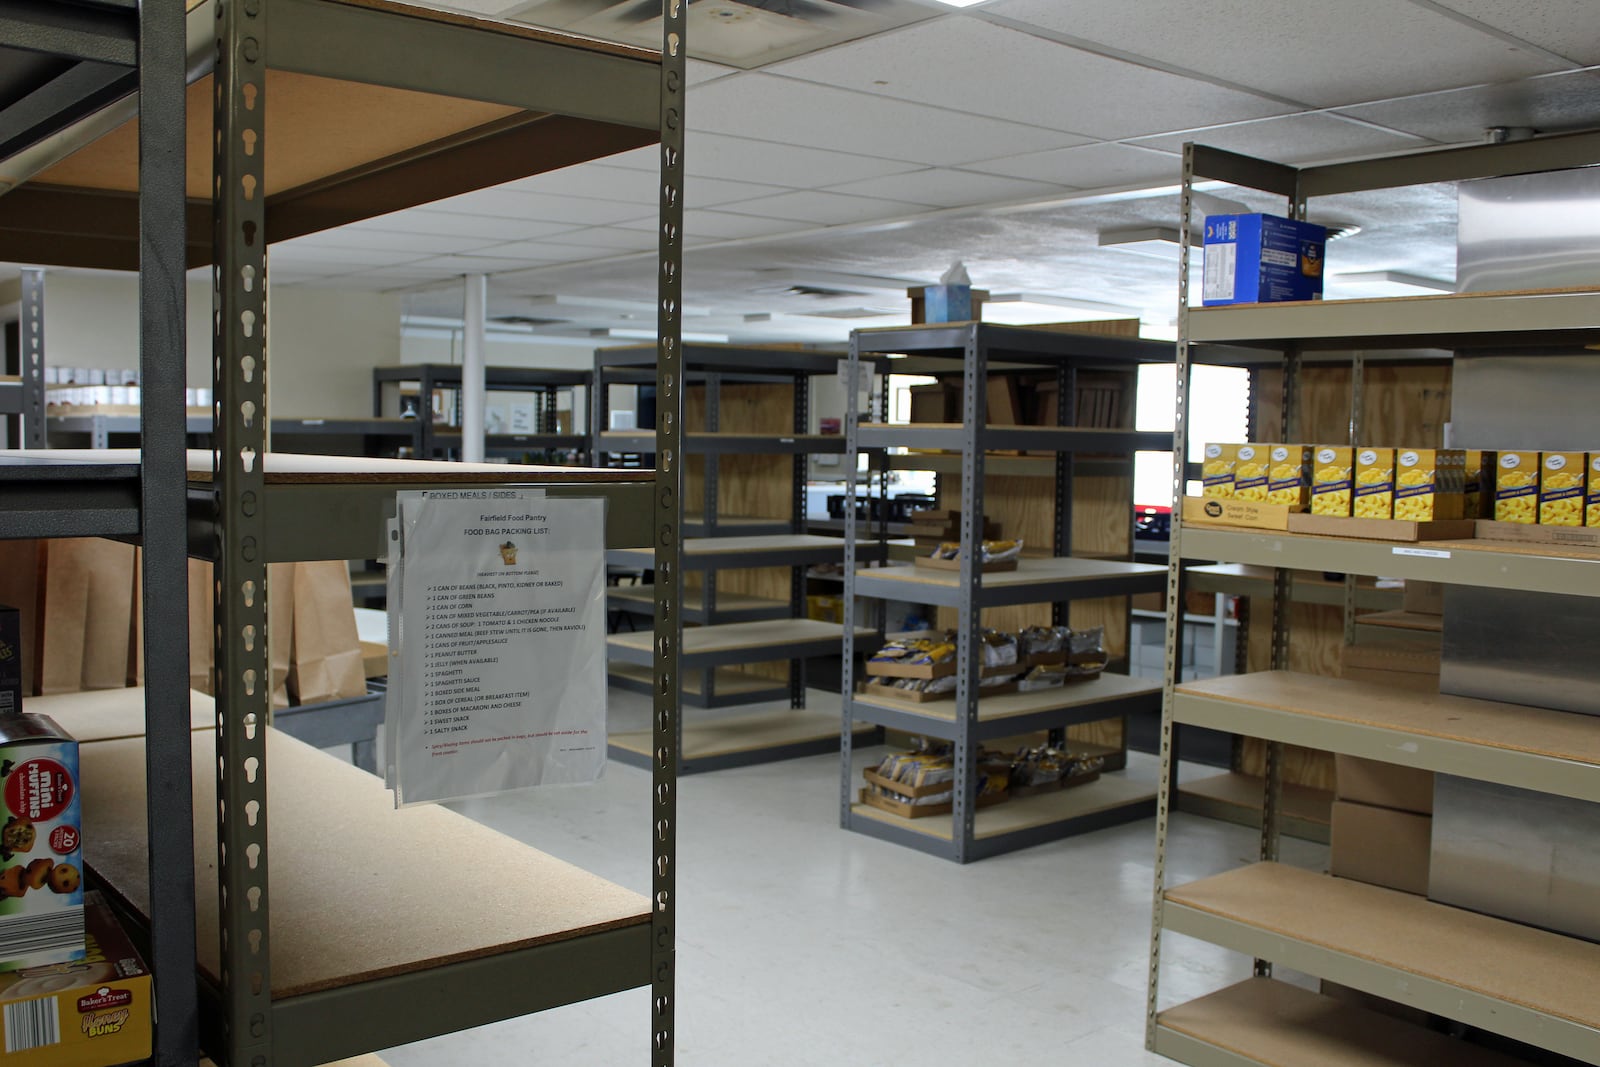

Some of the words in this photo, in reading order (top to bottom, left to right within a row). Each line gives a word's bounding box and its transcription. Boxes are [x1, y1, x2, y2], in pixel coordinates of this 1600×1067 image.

[525, 514, 546, 522] Pantry
[545, 580, 563, 588] BAKED)
[516, 617, 538, 625] CHICKEN
[435, 631, 458, 639] CANNED
[474, 629, 488, 637] (BEEF
[459, 637, 508, 647] FRUIT/APPLESAUCE
[435, 650, 456, 658] PEANUT
[457, 648, 477, 656] BUTTER
[450, 659, 468, 667] (WHEN
[469, 656, 498, 665] AVAILABLE)
[435, 669, 463, 677] SPAGHETTI
[435, 678, 463, 686] SPAGHETTI
[435, 688, 452, 696] BOXED
[475, 694, 484, 702] (OR
[485, 692, 514, 700] BREAKFAST
[515, 690, 530, 698] ITEM)
[435, 707, 452, 715] BOXES
[461, 704, 489, 712] MACARONI
[434, 726, 450, 734] SALTY
[451, 724, 468, 732] SNACK
[28, 763, 40, 818] MUFFINS
[40, 771, 54, 809] mini
[63, 832, 75, 847] 20
[80, 997, 106, 1006] Baker's
[106, 993, 128, 1002] Treat
[82, 1008, 128, 1033] Honey
[89, 1023, 121, 1037] BUNS
